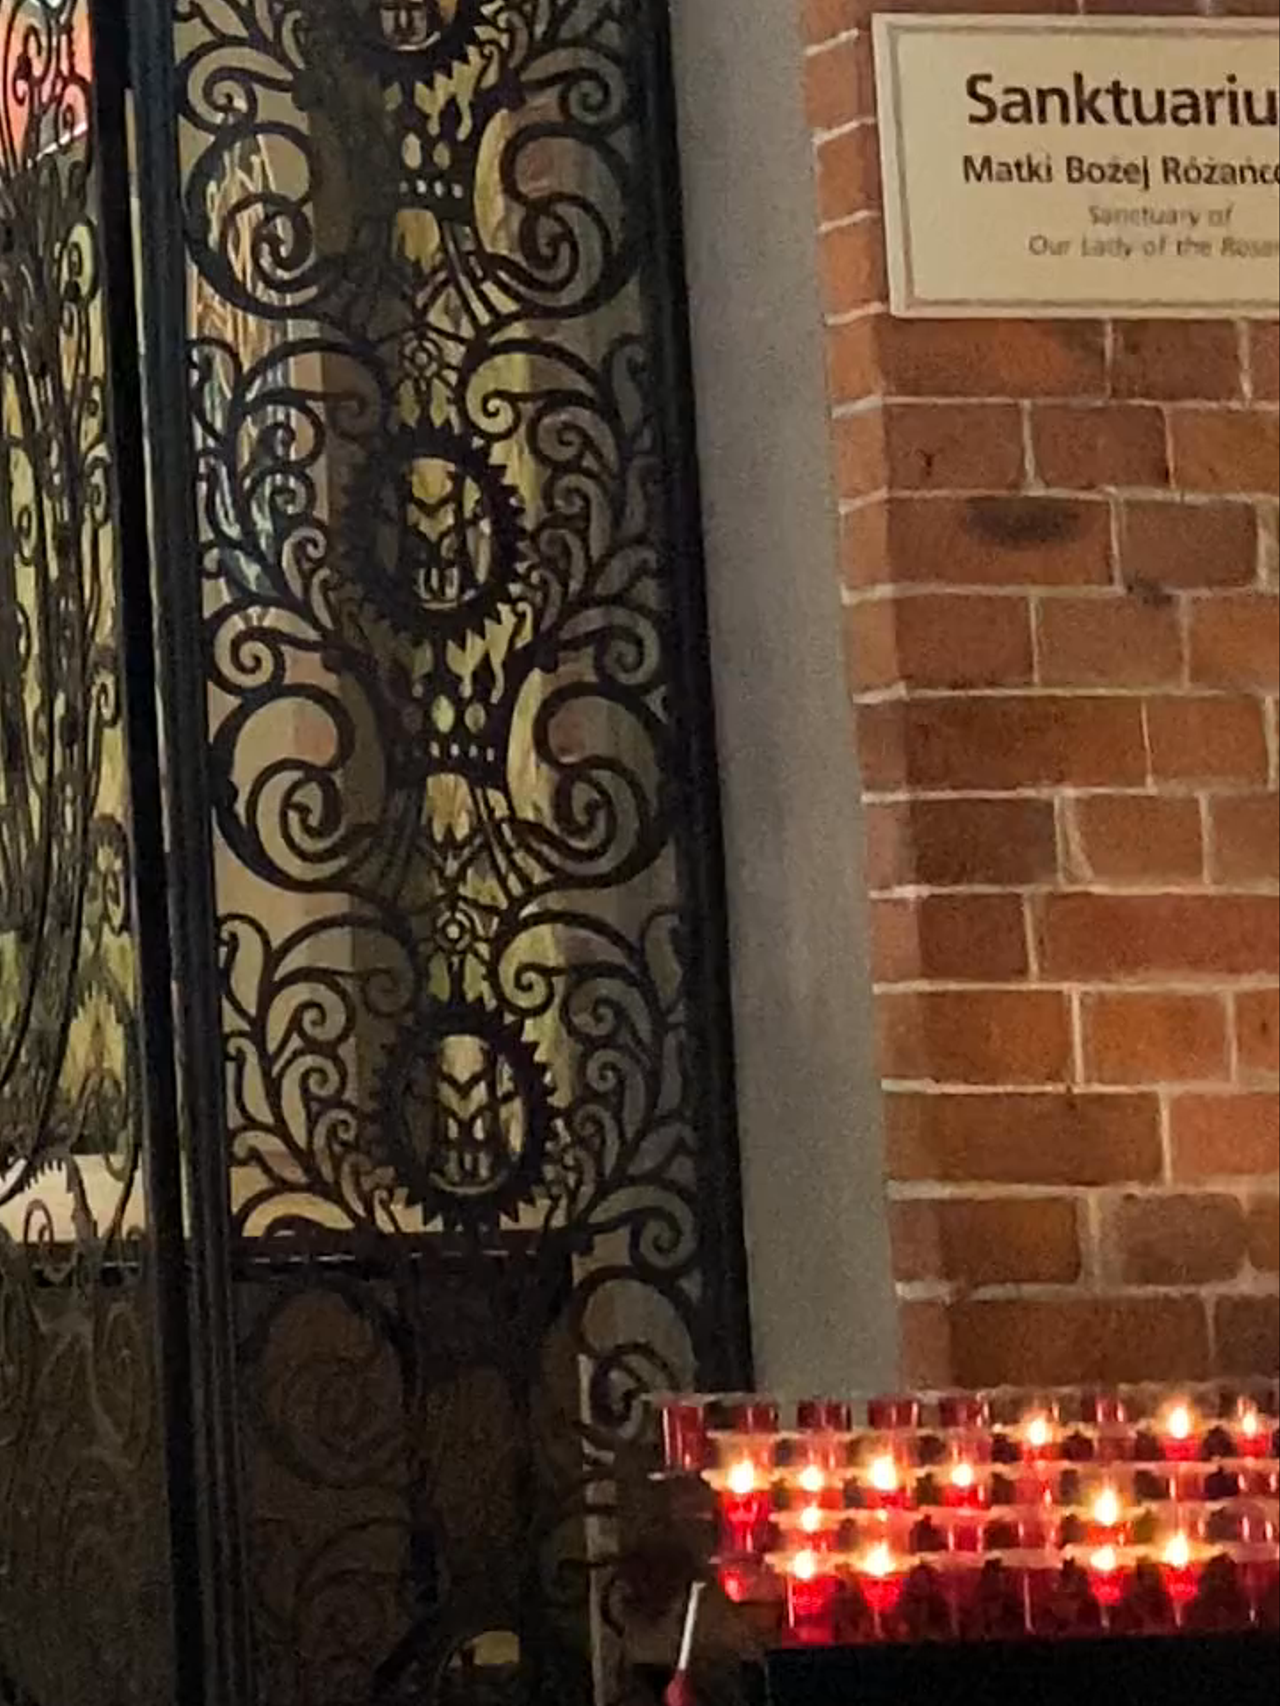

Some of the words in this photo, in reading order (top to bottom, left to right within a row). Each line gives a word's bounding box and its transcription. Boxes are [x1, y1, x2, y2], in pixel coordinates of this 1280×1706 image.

[963, 154, 1052, 183] Matki
[1066, 154, 1150, 191] Bożej
[1088, 205, 1201, 227] Sanctuary
[1207, 201, 1236, 227] of
[1028, 234, 1071, 256] Our
[1081, 234, 1132, 260] Lady
[1143, 234, 1167, 256] of
[1176, 236, 1212, 257] the
